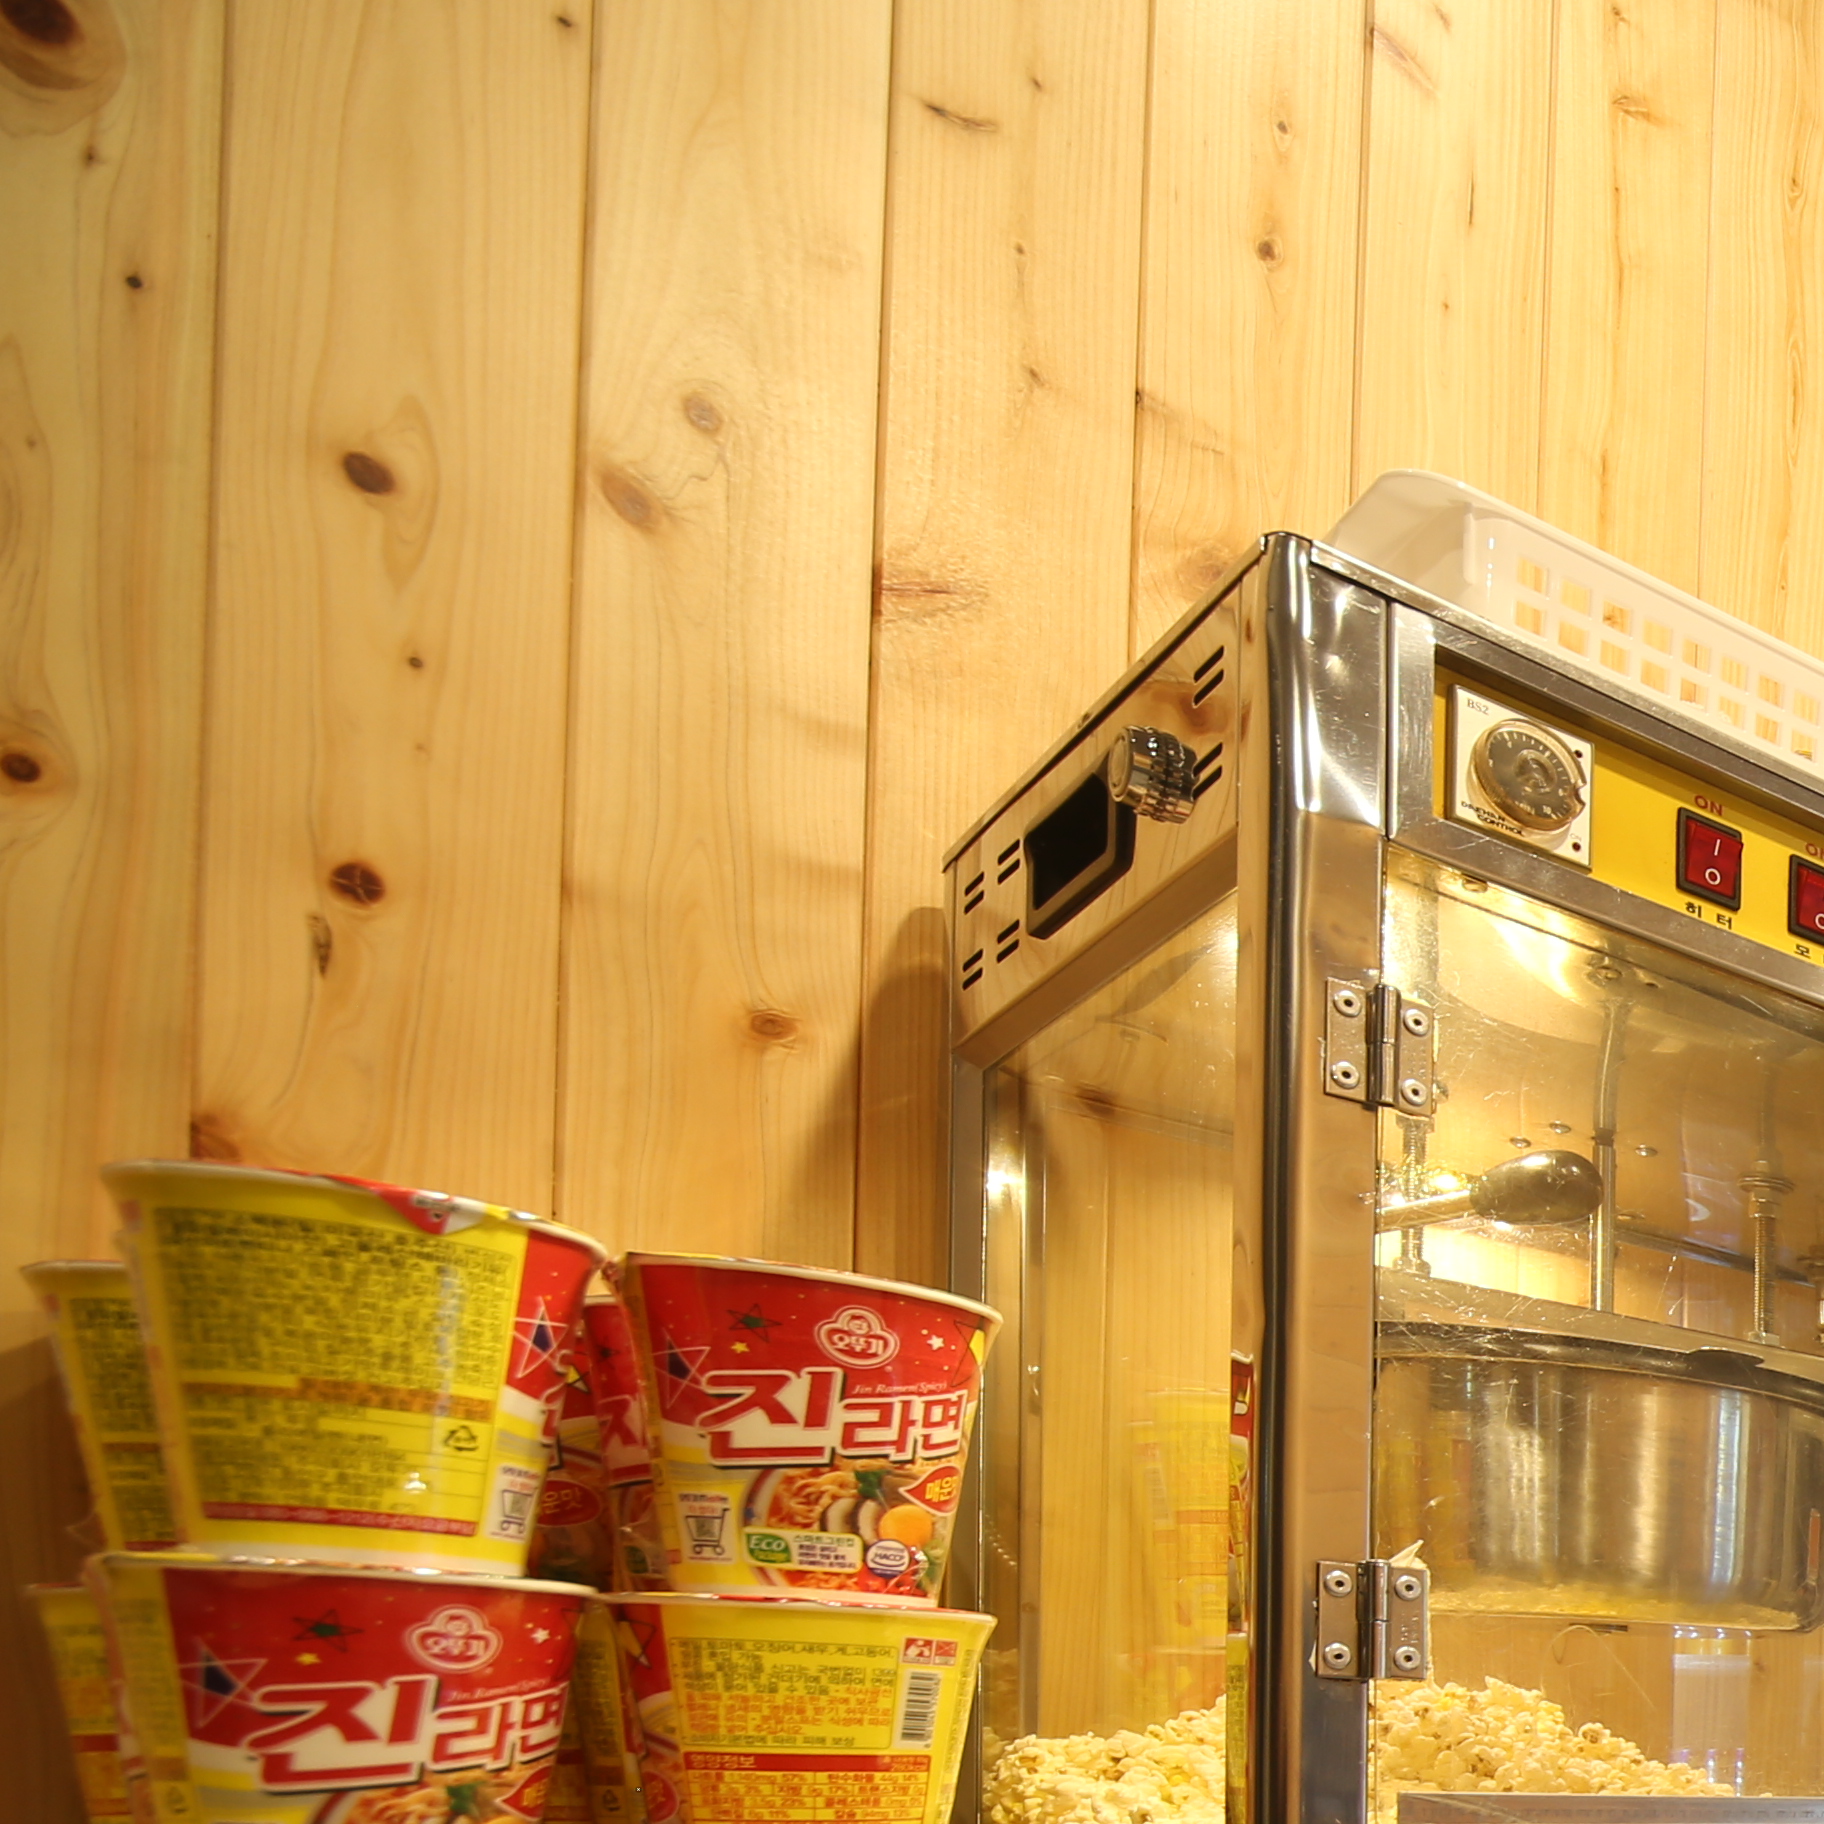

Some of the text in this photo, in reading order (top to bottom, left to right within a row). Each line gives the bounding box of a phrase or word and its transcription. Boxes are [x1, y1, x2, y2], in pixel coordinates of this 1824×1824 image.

[1467, 697, 1490, 717] BS2
[1694, 795, 1723, 816] ON
[1477, 814, 1524, 837] CONTROL
[832, 1333, 885, 1356] 오뚜기
[694, 1366, 971, 1468] 진라면
[243, 1674, 569, 1790] 진라면
[691, 1755, 757, 1769] 영양정보
